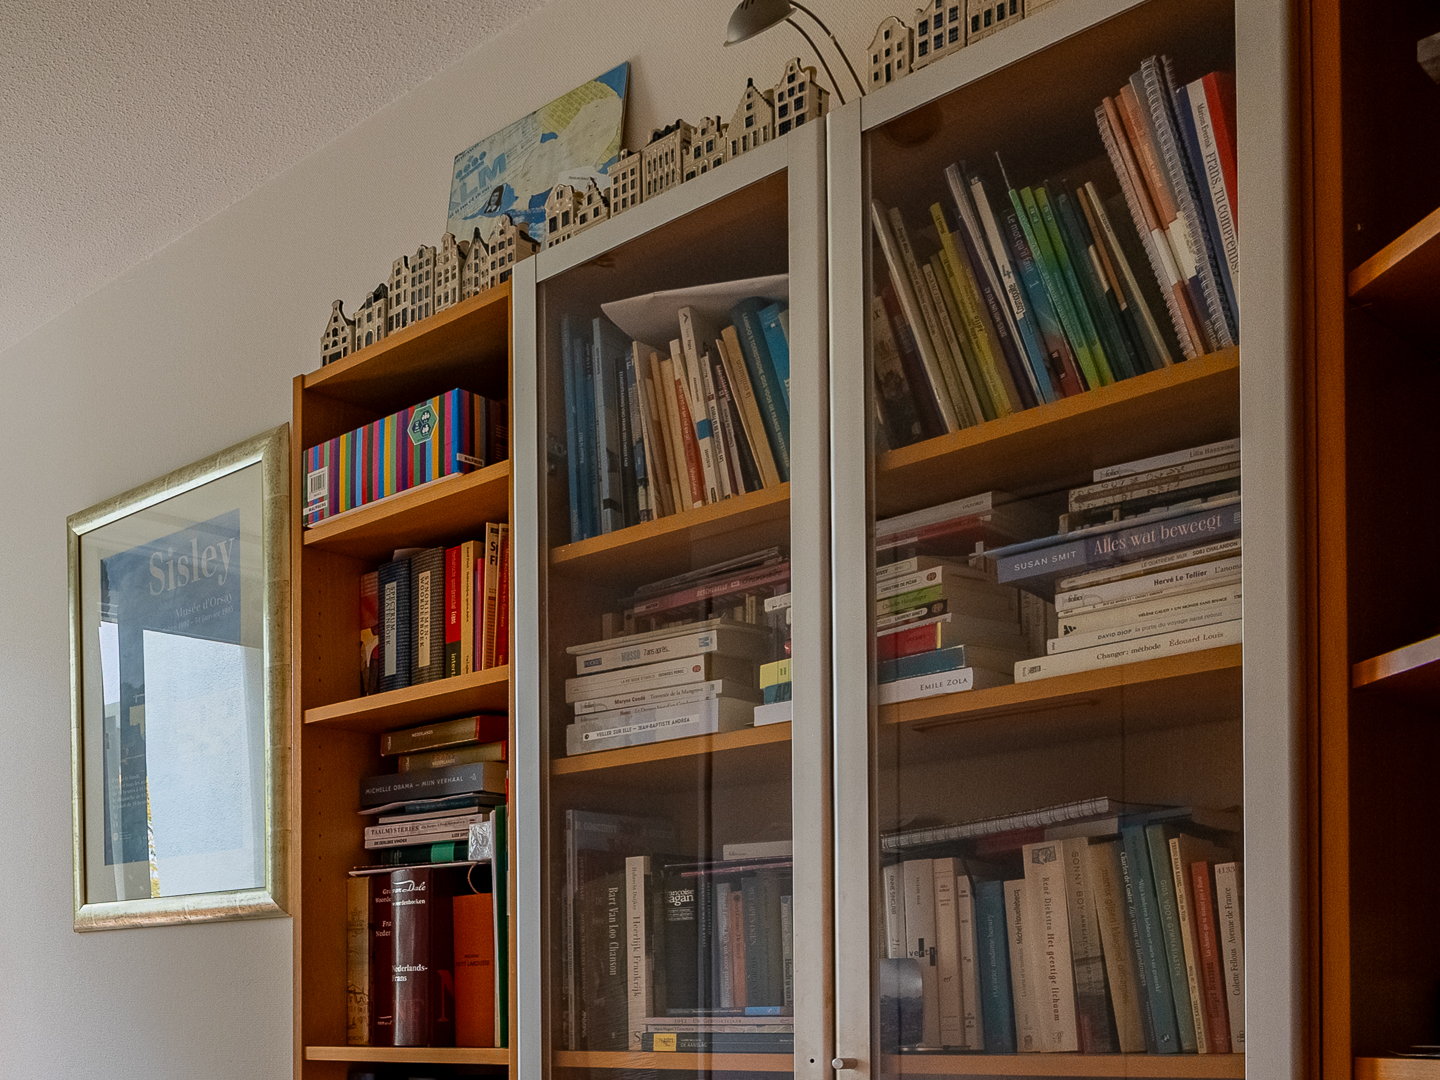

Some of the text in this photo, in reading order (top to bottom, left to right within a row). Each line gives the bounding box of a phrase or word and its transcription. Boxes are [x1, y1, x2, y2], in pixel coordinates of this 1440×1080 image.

[1197, 102, 1208, 129] Marion
[1206, 151, 1222, 189] Frans,
[1006, 213, 1040, 289] Le mot qu'il faut 1
[1014, 513, 1223, 572] SUSAN SMIT Alles wat beweegt
[149, 537, 235, 596] Sisley
[880, 584, 900, 593] CHRISTINE
[1067, 594, 1083, 603] folio
[175, 593, 233, 618] Musée d'Orsay
[1097, 632, 1116, 640] DAVID
[1116, 629, 1133, 637] DIOP
[1140, 625, 1156, 633] porte
[1166, 619, 1188, 629] voyage
[1130, 643, 1162, 655] méthode
[1169, 634, 1200, 647] Édouard
[1202, 632, 1224, 642] Louis
[614, 697, 630, 706] Maryse
[631, 696, 646, 704] Condé
[650, 692, 668, 700] Traversée
[680, 687, 704, 696] Mangrove
[919, 677, 969, 691] EMILE ZOLA
[596, 730, 611, 738] VEILLER
[637, 720, 670, 732] JEAN-BAPTISTE
[671, 717, 690, 725] ANDREA
[364, 785, 392, 795] MICHELLE
[393, 782, 413, 791] OBAMA
[436, 776, 464, 785] VERHAAL
[371, 825, 420, 835] TAALMYSTERIES
[1013, 889, 1024, 945] Michel Houellebecq
[1159, 879, 1182, 977] GIDS VOOR GYMNASIASTEN
[608, 886, 620, 976] Bart Van Loo Chanson
[1224, 887, 1241, 996] Colette Fellous Avenue de France
[632, 916, 641, 998] Heerlijk Frankrijk
[1042, 876, 1061, 1022] René Diekstra Het geestige lichaam
[392, 964, 428, 973] Nederlands-
